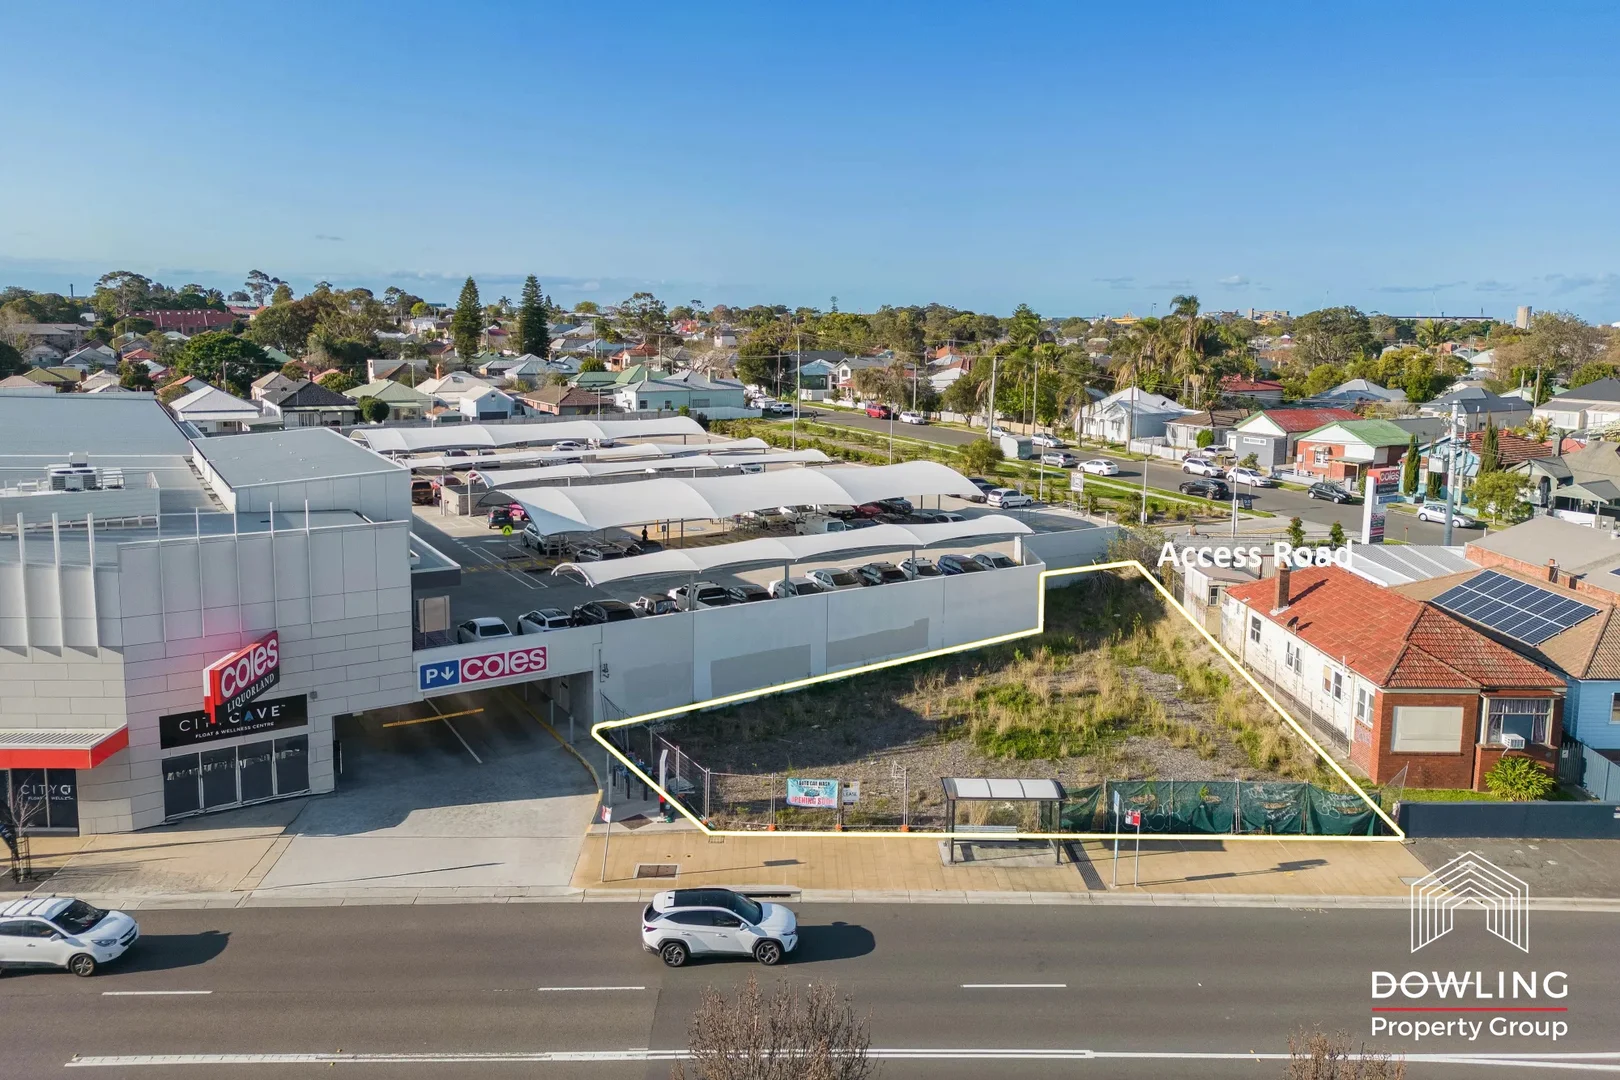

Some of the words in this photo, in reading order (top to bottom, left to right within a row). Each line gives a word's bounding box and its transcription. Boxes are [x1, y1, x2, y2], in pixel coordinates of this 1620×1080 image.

[1380, 471, 1400, 482] coles
[221, 639, 278, 698] coles
[462, 648, 546, 681] coles
[426, 669, 438, 684] P
[227, 673, 275, 713] LIQUORLAND
[195, 731, 214, 739] FLOAT
[221, 726, 252, 735] WELLNESS
[252, 721, 275, 730] CENTRE
[20, 784, 58, 795] CITY
[791, 796, 817, 805] OPENING
[817, 797, 834, 806] SOON
